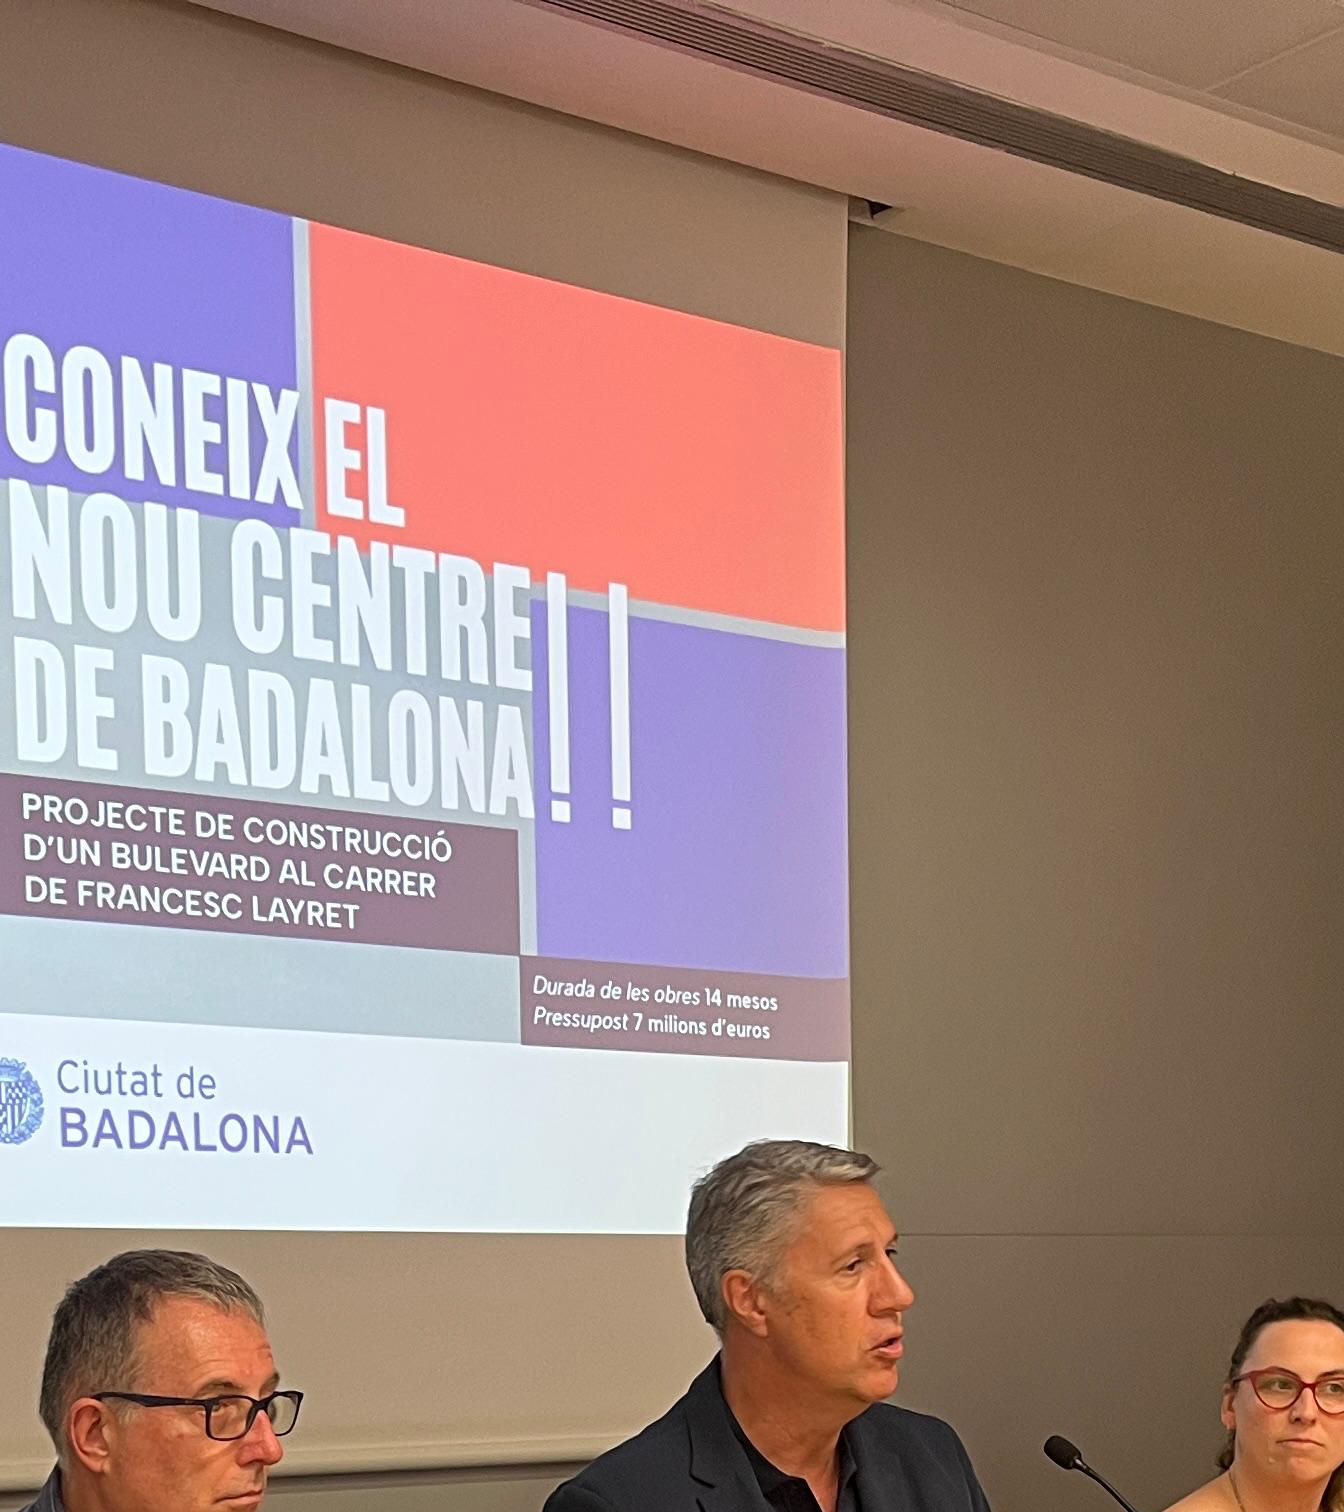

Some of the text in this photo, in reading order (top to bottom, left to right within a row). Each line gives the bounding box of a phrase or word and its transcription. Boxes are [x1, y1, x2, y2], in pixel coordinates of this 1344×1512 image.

[2, 333, 405, 527] CONEIX EL
[8, 478, 533, 691] NOU CENTRE
[14, 635, 536, 819] DE BADALONA
[22, 793, 452, 862] PROJECTE DE CONSTRUCCIÓ
[24, 833, 436, 898] D'UN BULEVARD AL CARRER
[25, 875, 360, 930] DE FRANCESC LAYRET
[533, 975, 778, 1011] Durada de les obres 14 mesos
[533, 1006, 771, 1039] Pressupost 7 milions d'euros
[57, 1059, 217, 1100] Ciutat de
[60, 1106, 314, 1155] BADALONA
